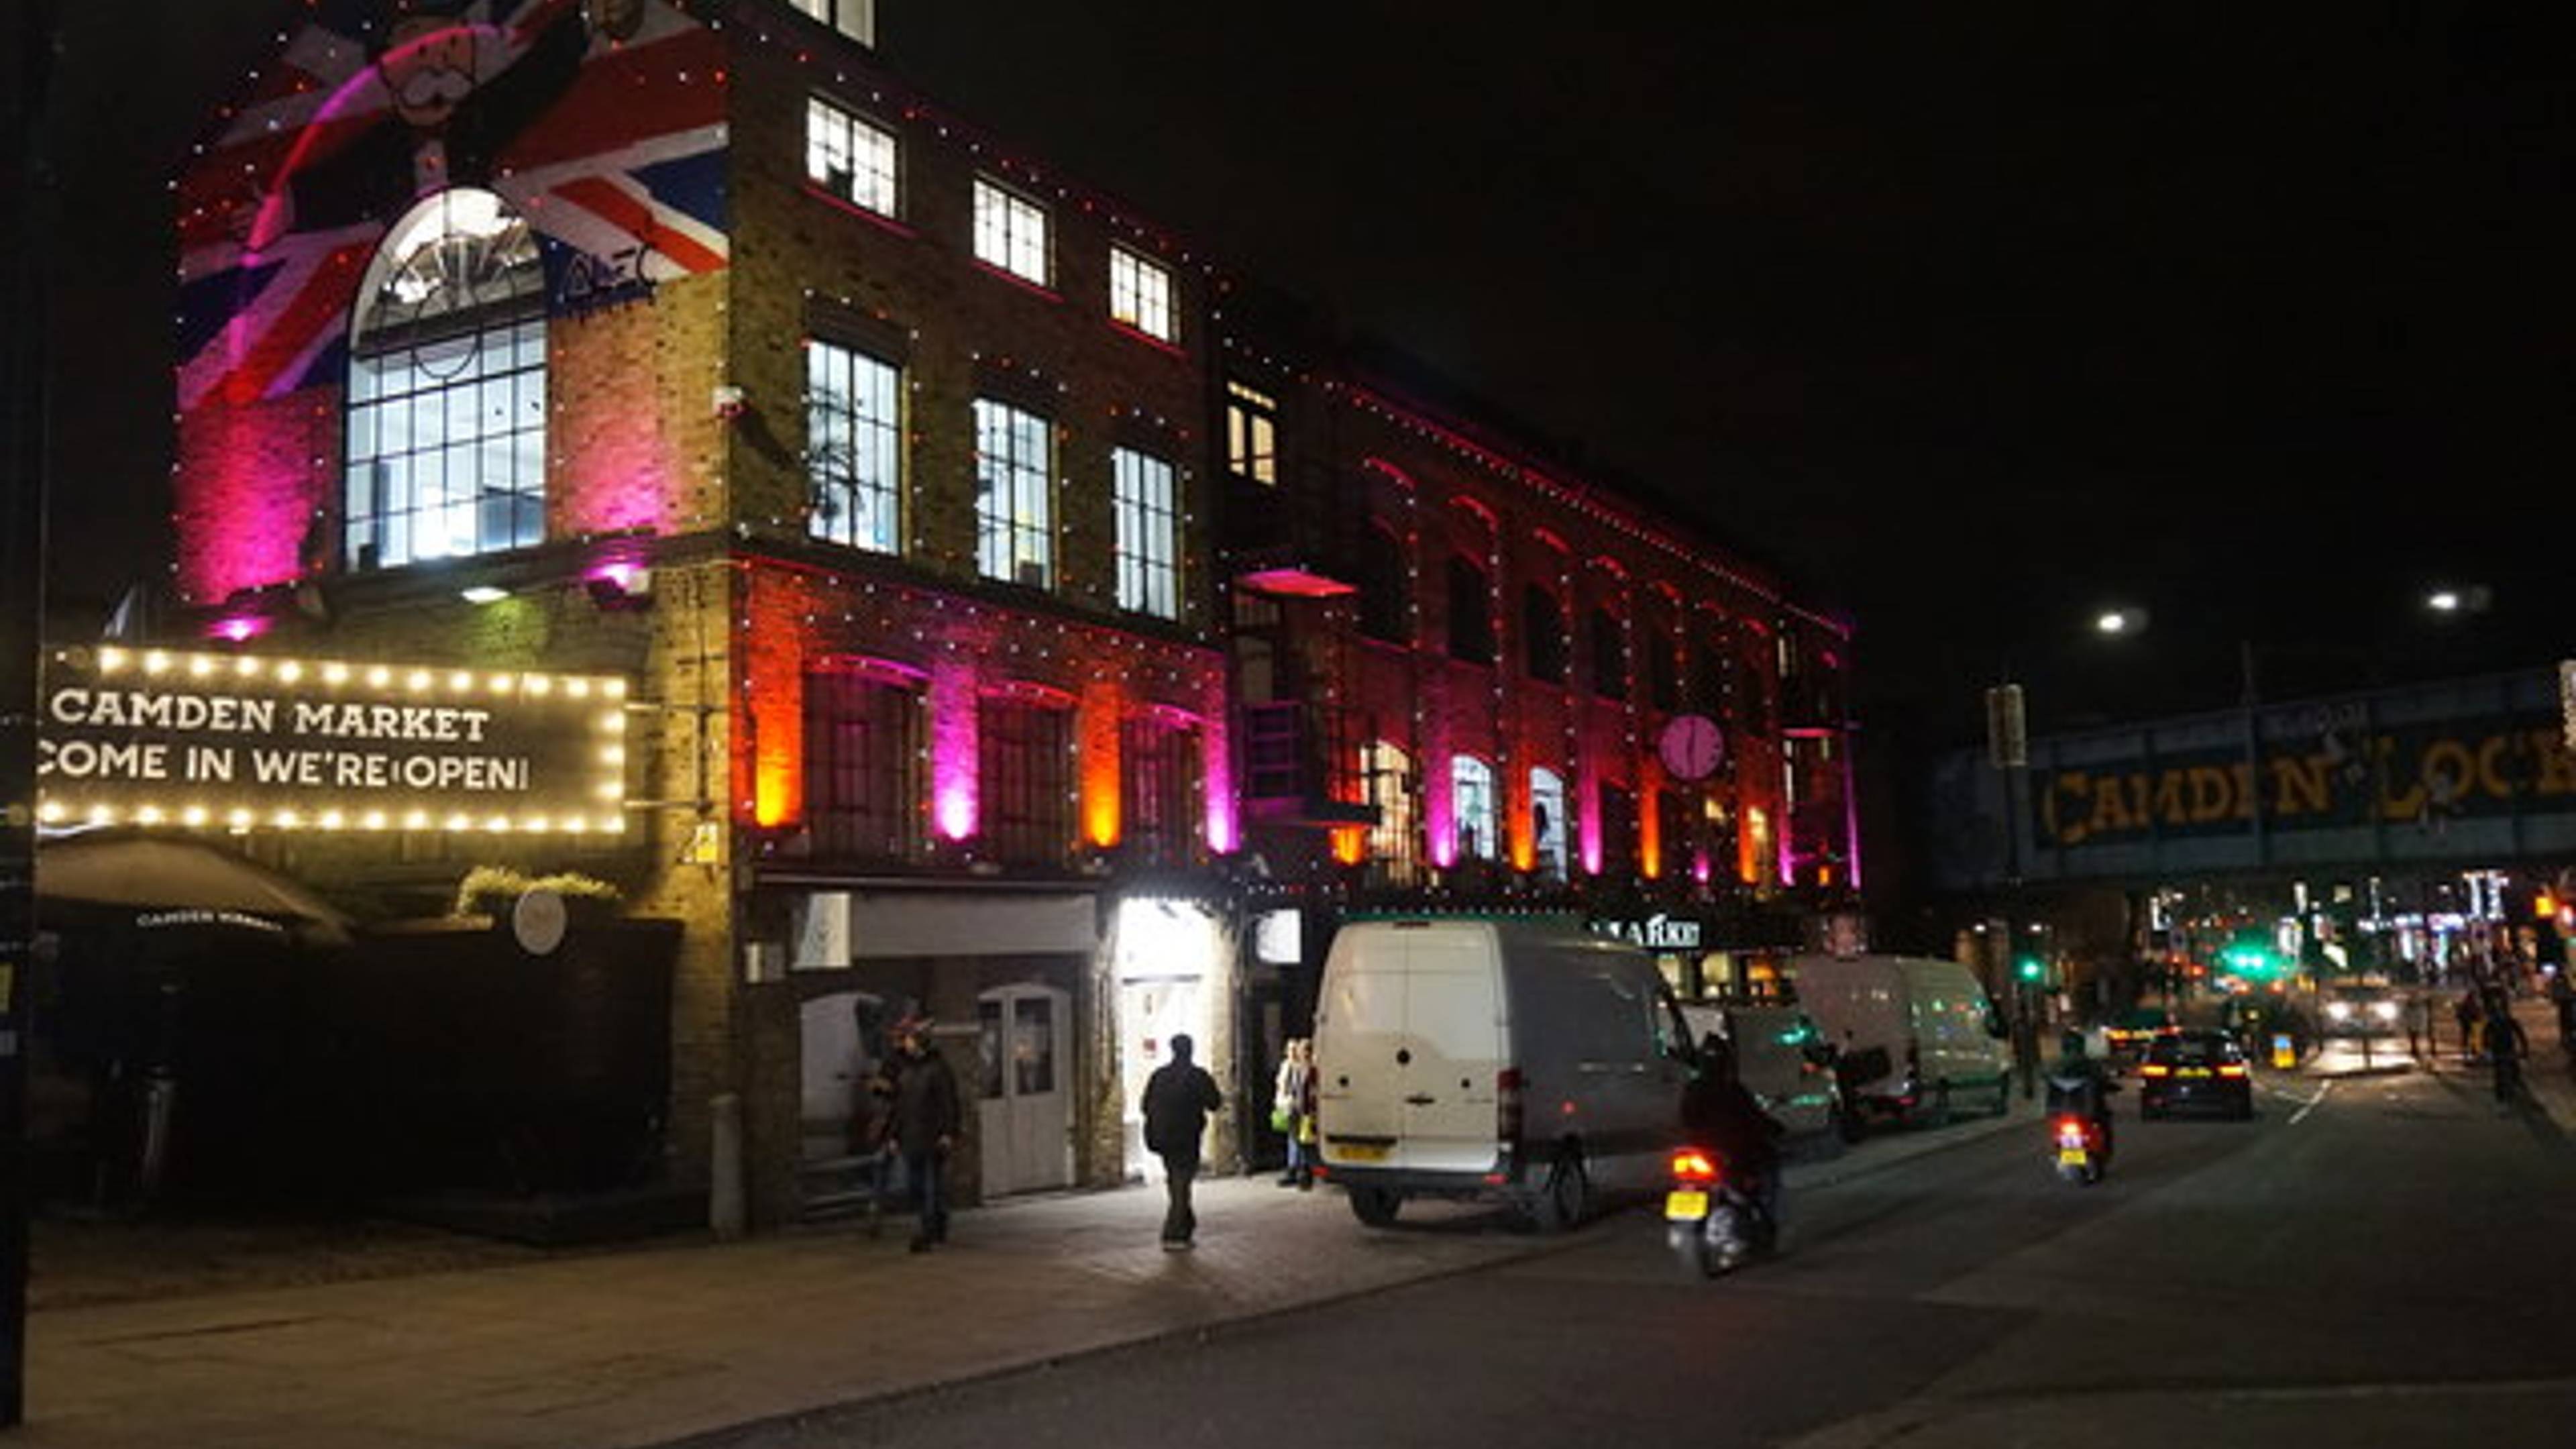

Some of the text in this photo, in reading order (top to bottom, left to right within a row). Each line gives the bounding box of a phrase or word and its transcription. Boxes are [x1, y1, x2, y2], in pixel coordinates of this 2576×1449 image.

[51, 688, 489, 741] CAMDEN MARKET
[187, 746, 232, 781] IN
[253, 749, 387, 787] WE'RE
[2042, 754, 2341, 844] CAMDEN
